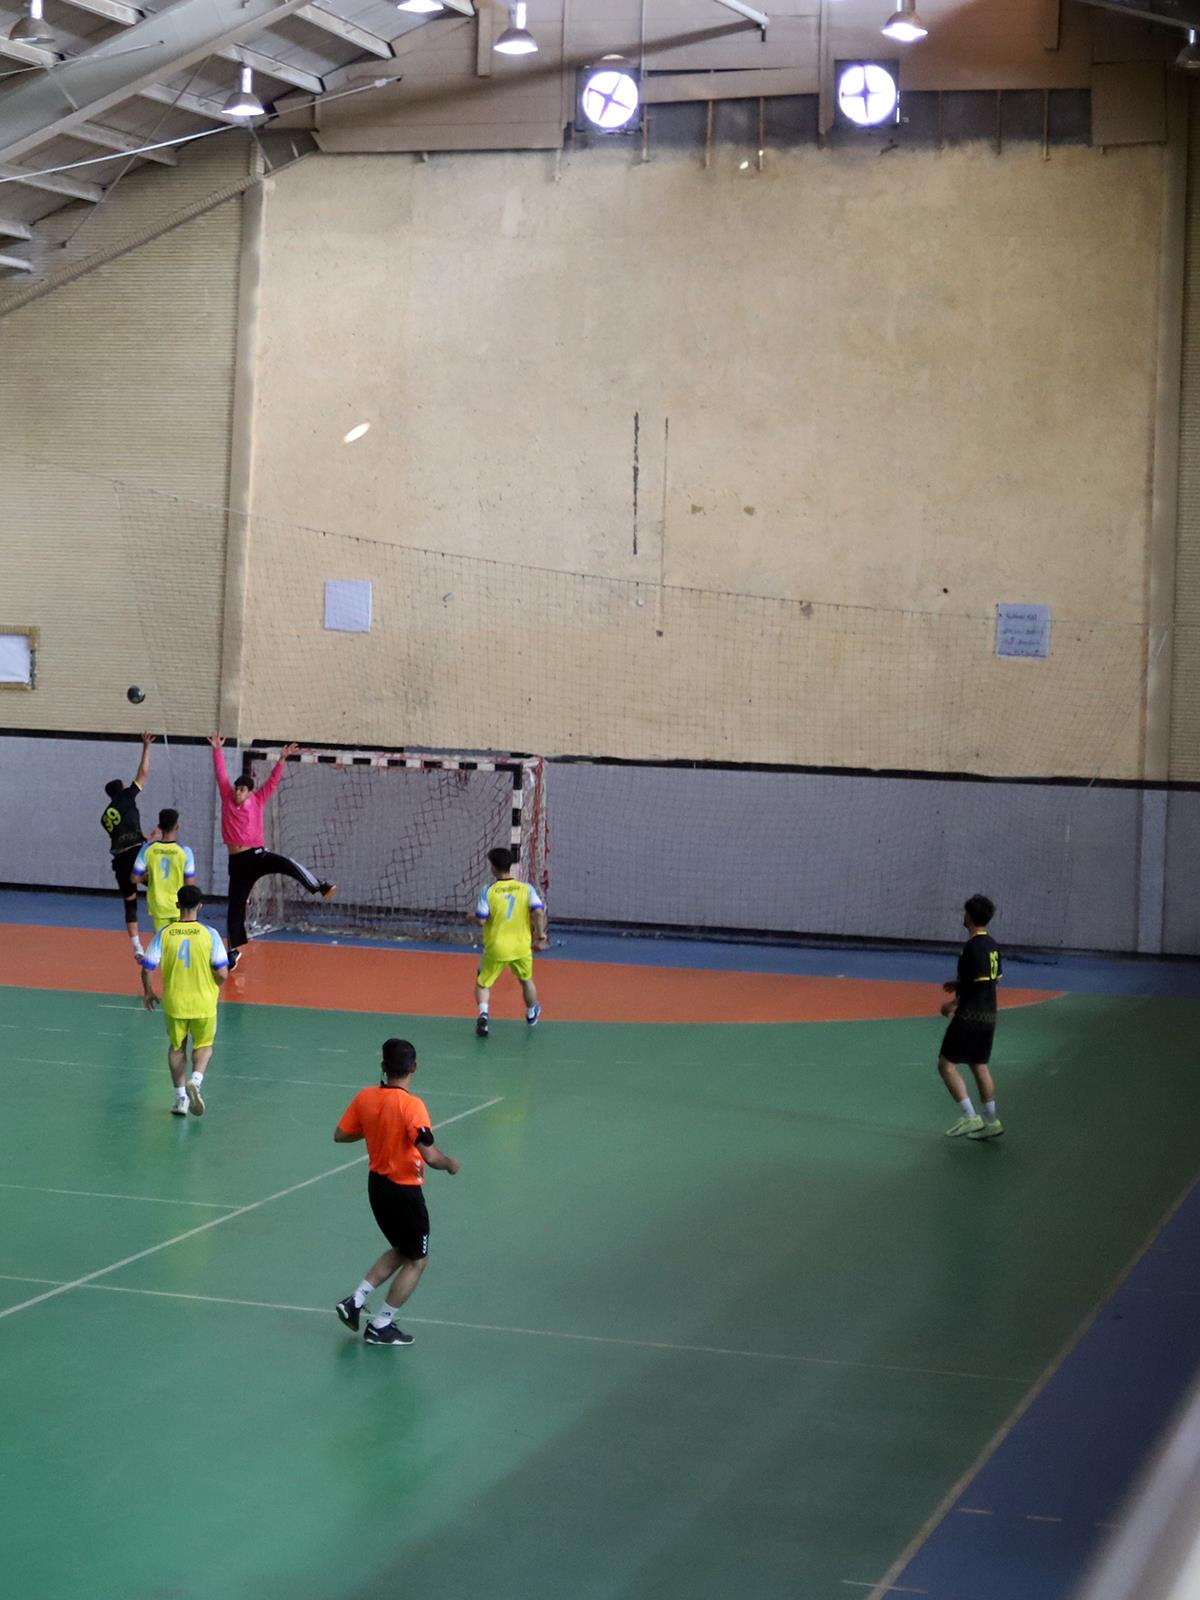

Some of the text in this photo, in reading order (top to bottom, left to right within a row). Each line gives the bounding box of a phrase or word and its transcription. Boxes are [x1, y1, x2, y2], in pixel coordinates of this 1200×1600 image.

[160, 856, 171, 881] 9
[504, 893, 516, 920] 7
[177, 938, 191, 969] 4
